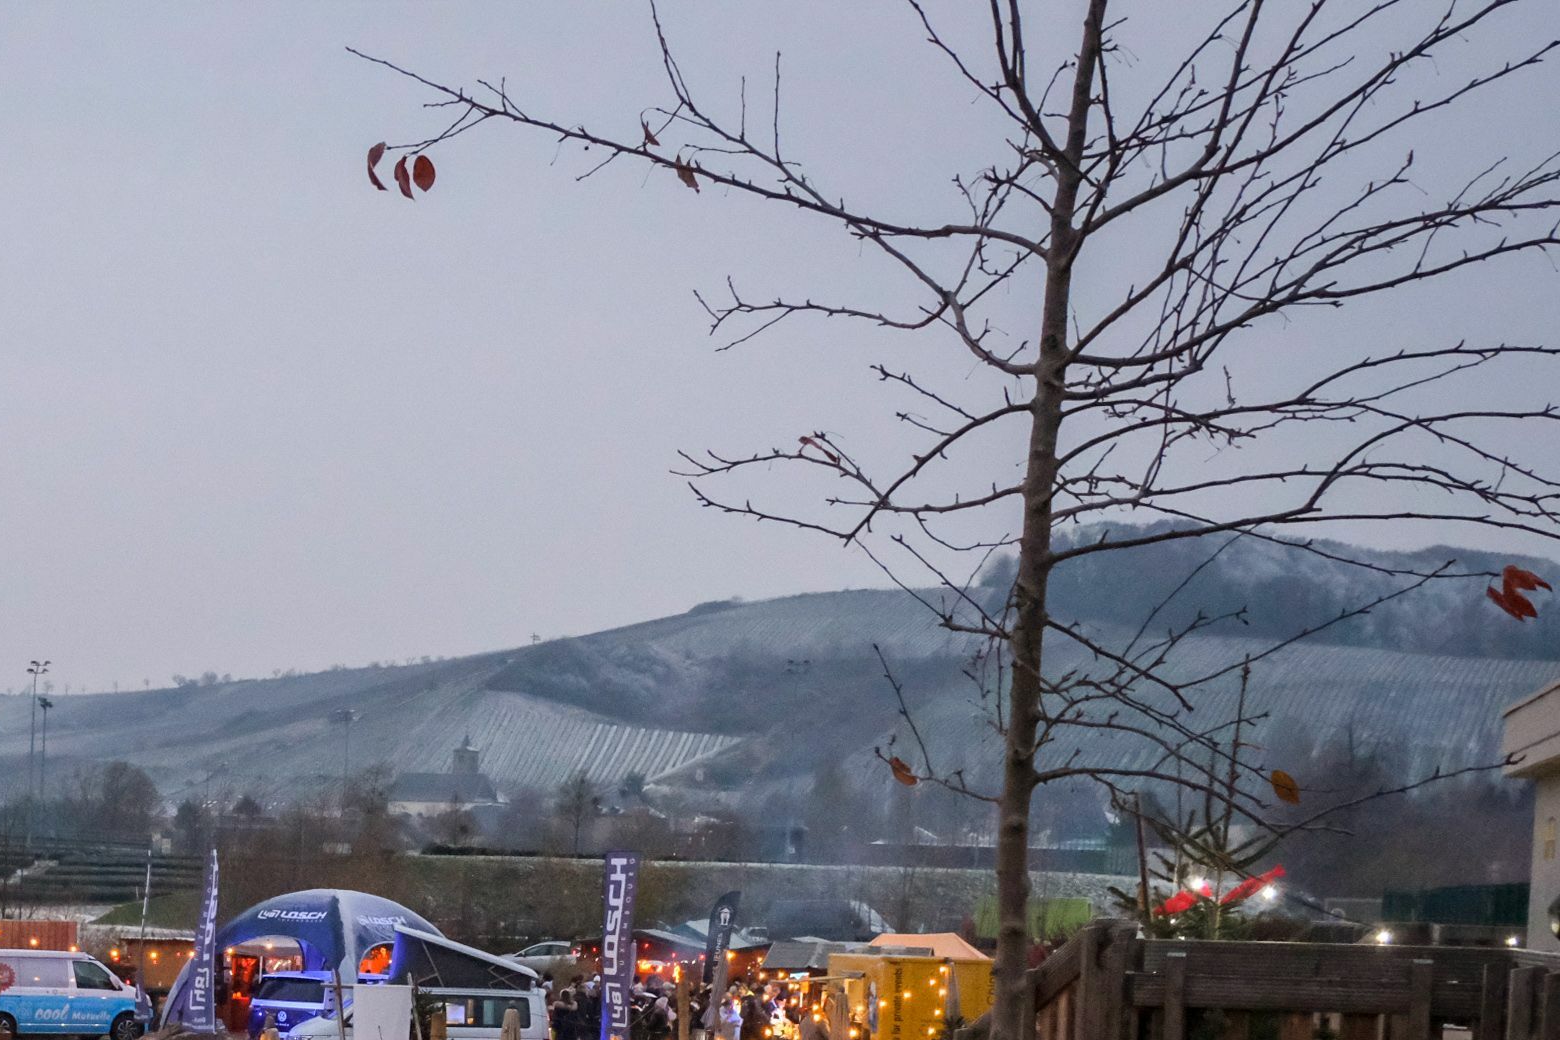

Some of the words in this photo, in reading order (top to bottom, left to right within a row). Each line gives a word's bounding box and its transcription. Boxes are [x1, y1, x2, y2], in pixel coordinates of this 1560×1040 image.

[281, 910, 328, 920] LOSCH
[368, 915, 407, 925] LOSCH
[603, 857, 627, 976] LOSCH
[618, 857, 637, 978] LUXEMBOURG
[894, 967, 903, 994] events
[34, 1003, 70, 1021] cool
[892, 995, 903, 1023] private
